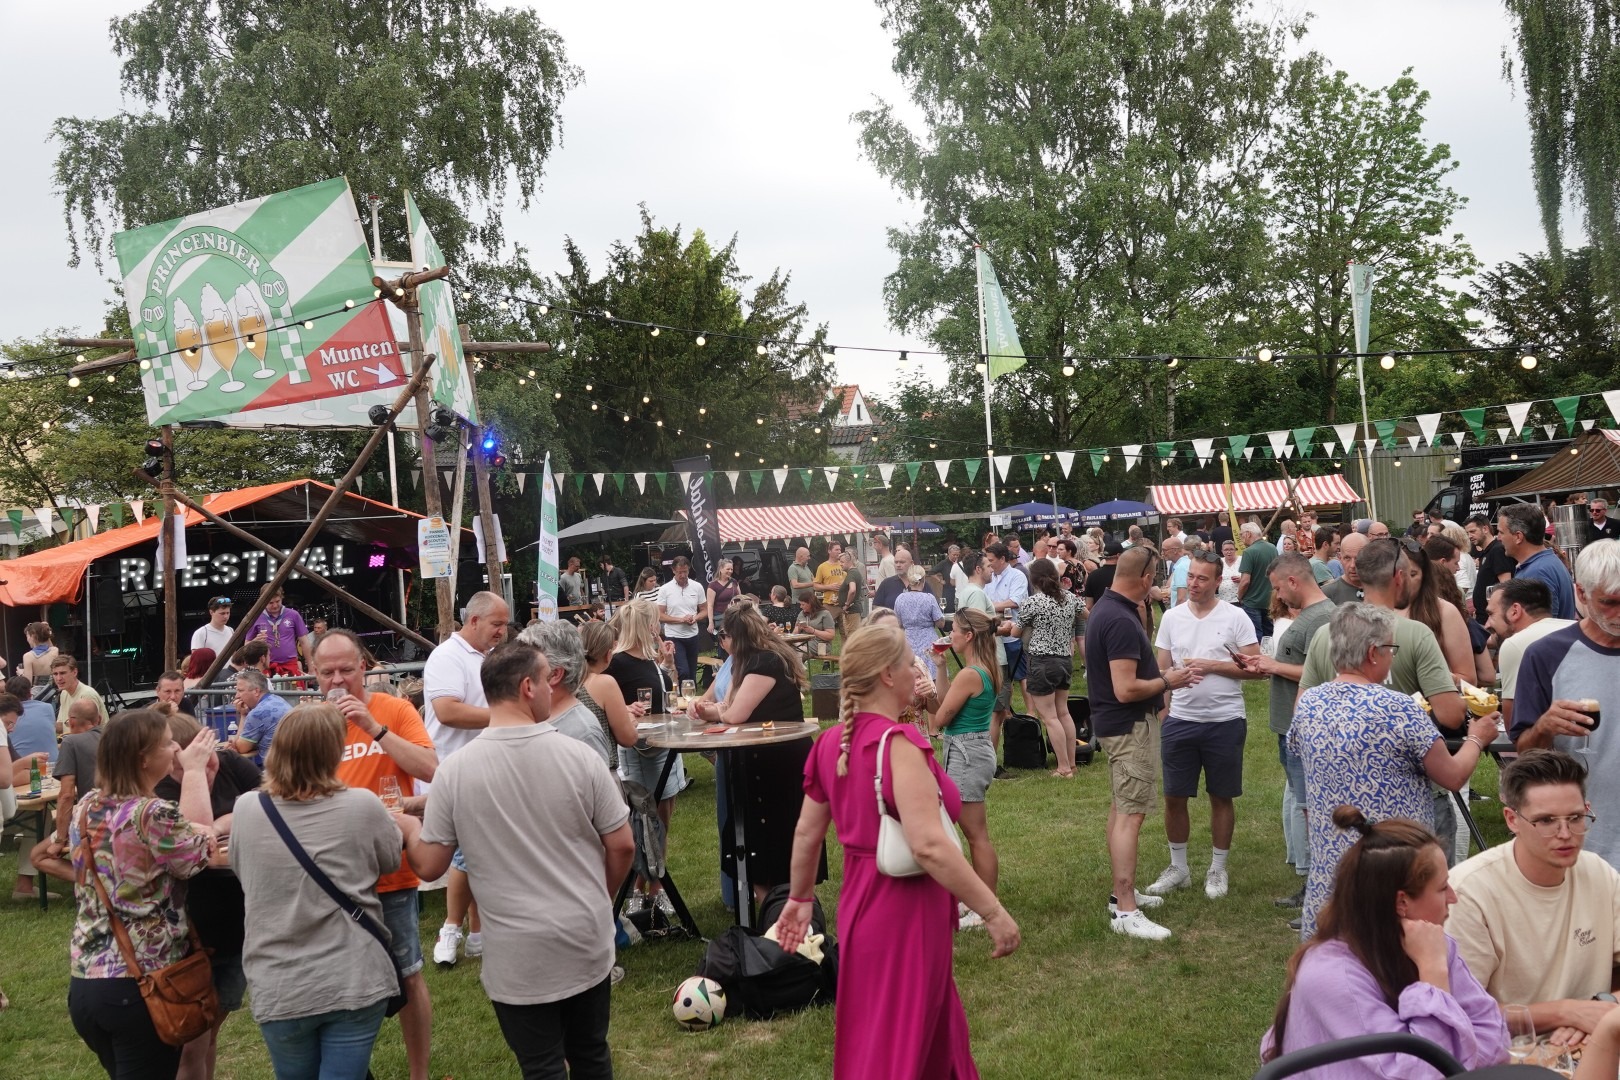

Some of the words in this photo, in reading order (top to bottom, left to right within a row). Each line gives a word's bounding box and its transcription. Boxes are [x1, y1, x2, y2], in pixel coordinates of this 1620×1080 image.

[151, 232, 260, 296] PRINCENBIER
[319, 340, 395, 366] Munten
[327, 369, 360, 390] WC
[1470, 474, 1484, 482] KEEP
[1470, 481, 1485, 490] CALM
[341, 740, 387, 762] EDA
